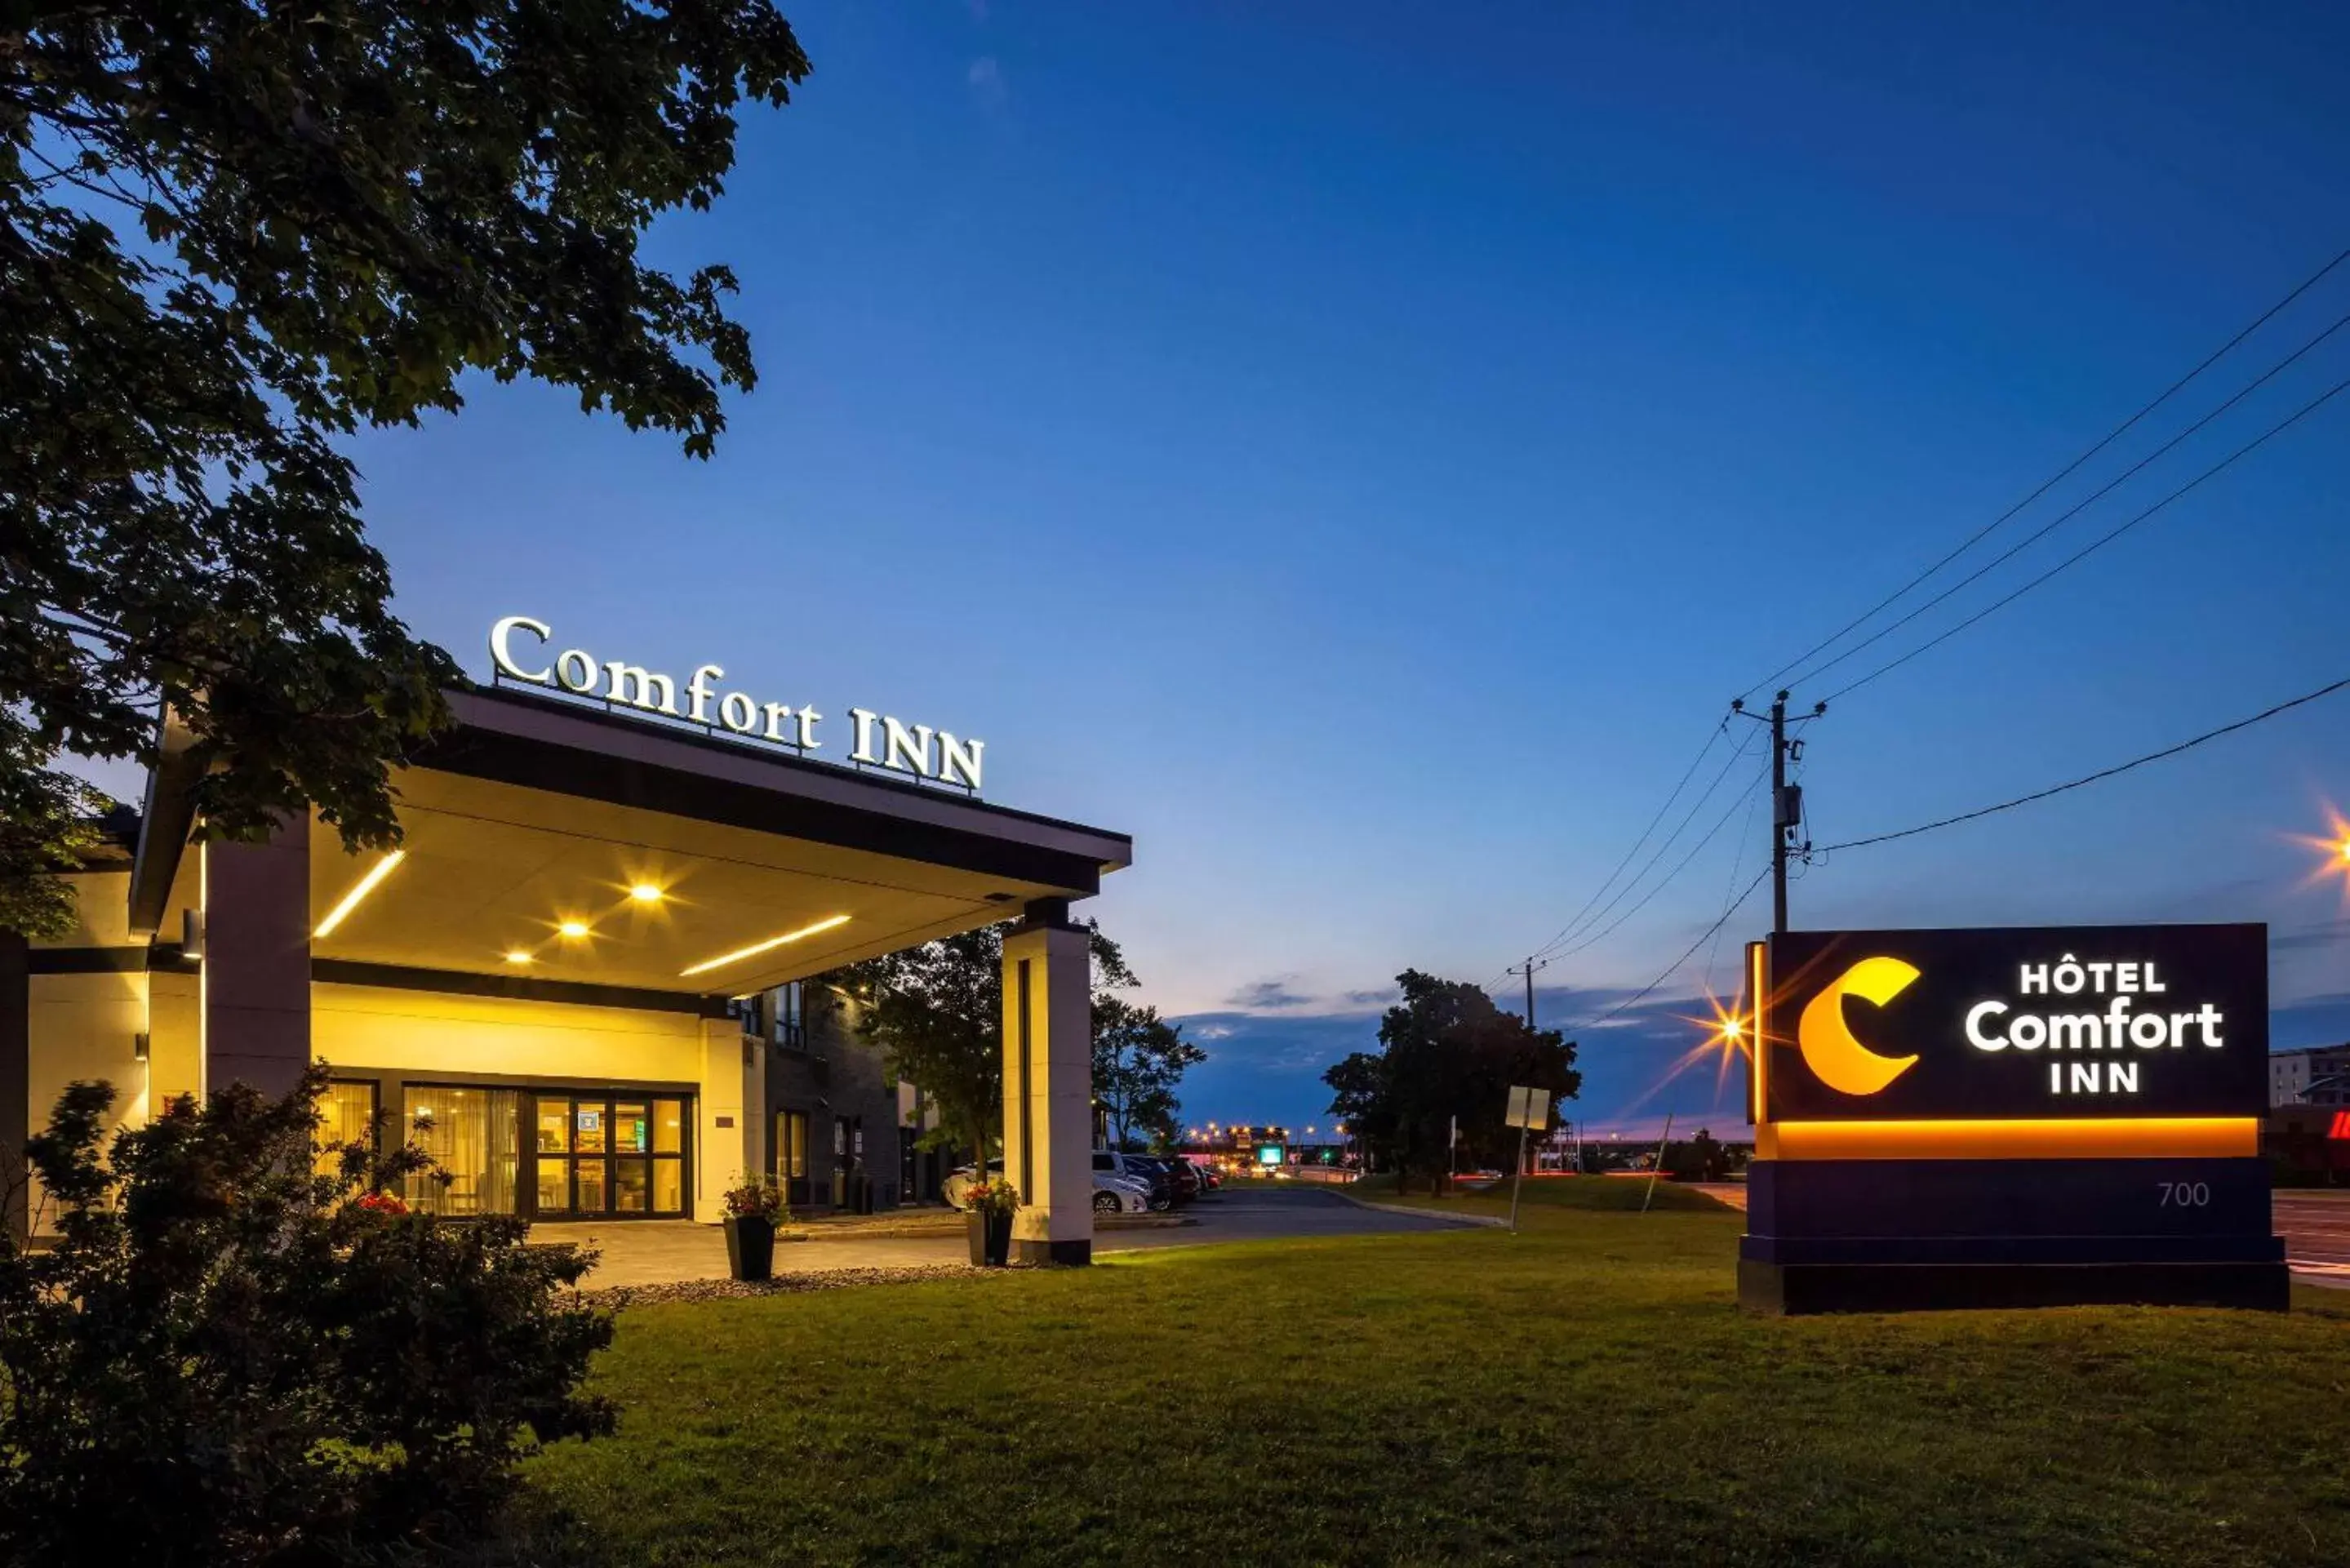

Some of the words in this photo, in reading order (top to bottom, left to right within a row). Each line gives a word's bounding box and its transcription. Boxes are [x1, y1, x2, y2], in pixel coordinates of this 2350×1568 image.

[489, 615, 823, 749] Comfort
[848, 707, 985, 789] INN
[2020, 953, 2166, 994] HÔTEL
[1966, 996, 2223, 1052] Comfort
[2050, 1062, 2139, 1094] INN
[2157, 1182, 2210, 1207] 700
